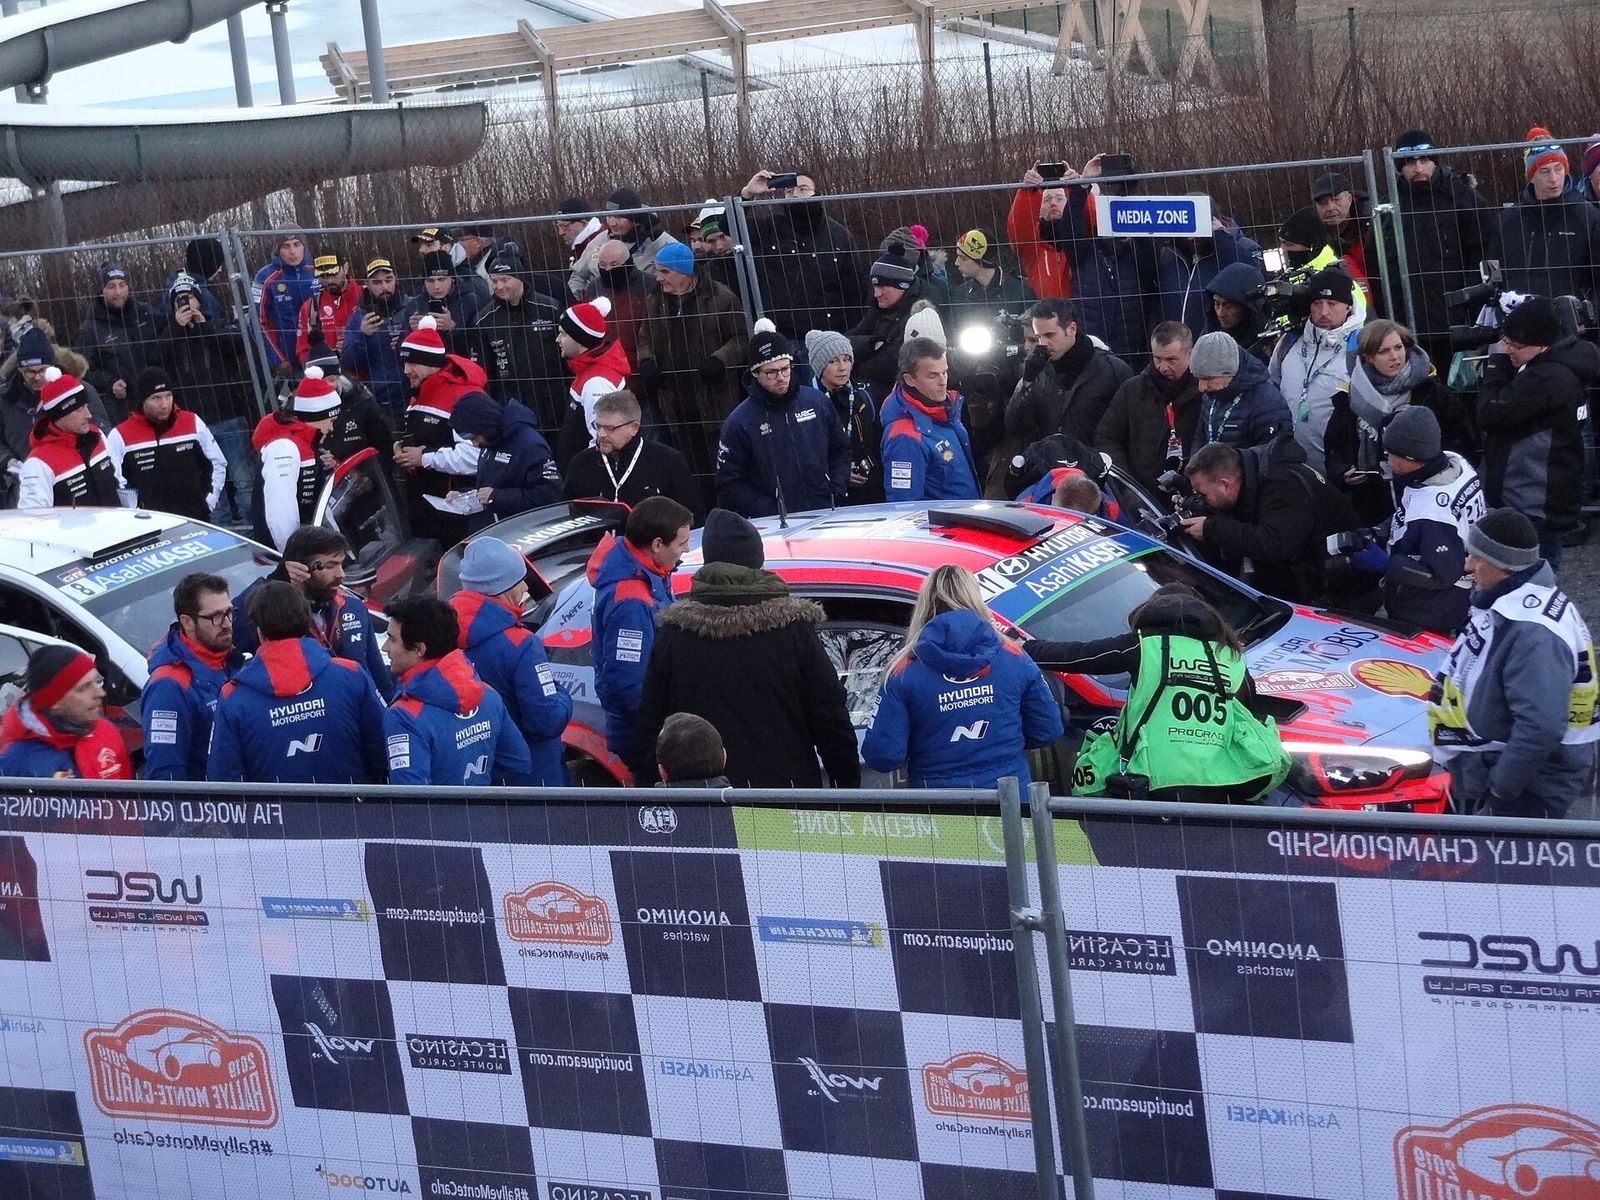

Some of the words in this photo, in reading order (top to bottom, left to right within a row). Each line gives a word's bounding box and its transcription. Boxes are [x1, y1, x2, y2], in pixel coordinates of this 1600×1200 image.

[1117, 209, 1152, 225] MEDIA
[1156, 209, 1189, 225] ZONE
[518, 514, 602, 547] HYUNDAI
[1024, 524, 1097, 563] HYUNDAI
[85, 552, 133, 572] TOYOTA
[94, 540, 212, 590] AsahiKASEI
[1025, 539, 1131, 599] AsahiKASEI
[70, 583, 95, 596] 8
[562, 600, 584, 624] here
[1287, 627, 1380, 671] MOBIS
[938, 684, 994, 704] HYUNDAI
[939, 695, 994, 712] MOTORSPORT
[269, 698, 325, 719] HYUNDAI
[271, 708, 326, 727] MOTORSPORT
[1171, 691, 1228, 727] 005
[455, 720, 491, 742] HYUNDAI
[456, 730, 492, 750] MOTORSPORT
